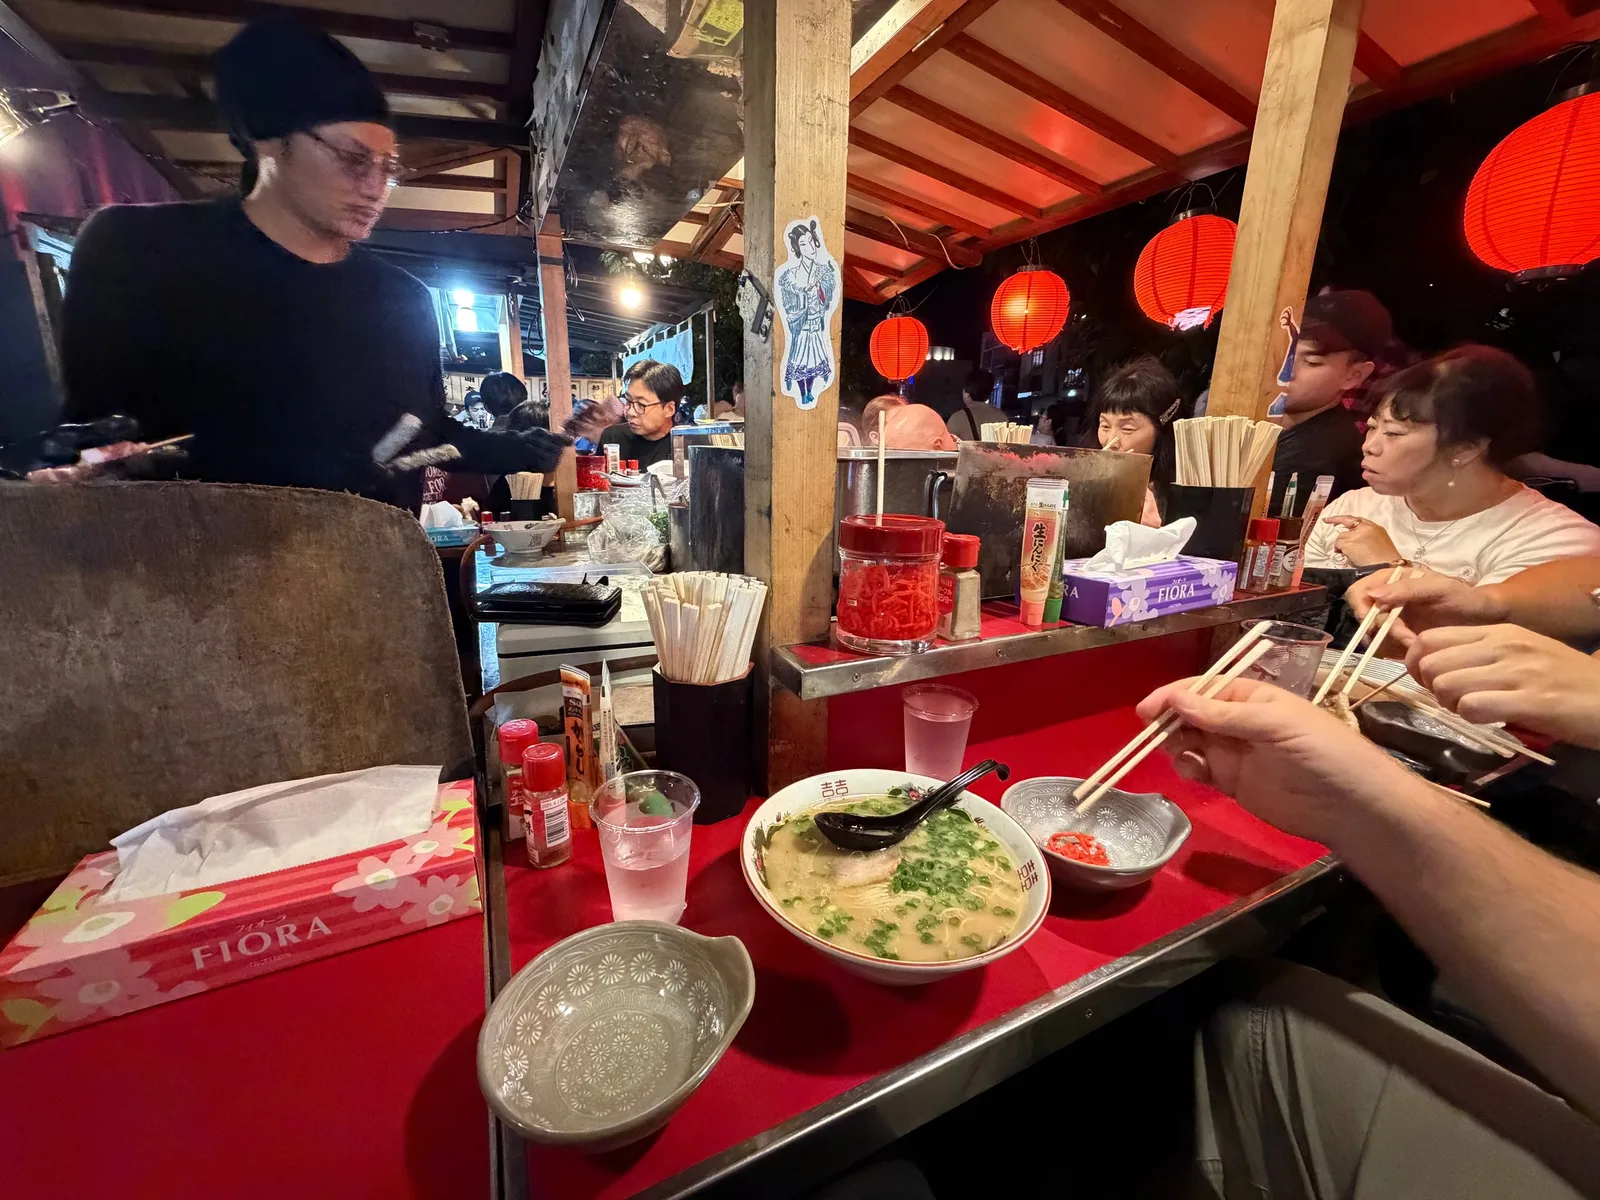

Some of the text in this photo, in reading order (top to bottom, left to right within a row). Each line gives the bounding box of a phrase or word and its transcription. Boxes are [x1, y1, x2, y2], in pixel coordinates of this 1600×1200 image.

[1031, 523, 1046, 572] 生にんにく
[1157, 583, 1195, 603] FIORA
[570, 720, 585, 776] からし
[191, 915, 333, 970] FIORA
[235, 914, 287, 934] フィオーラ
